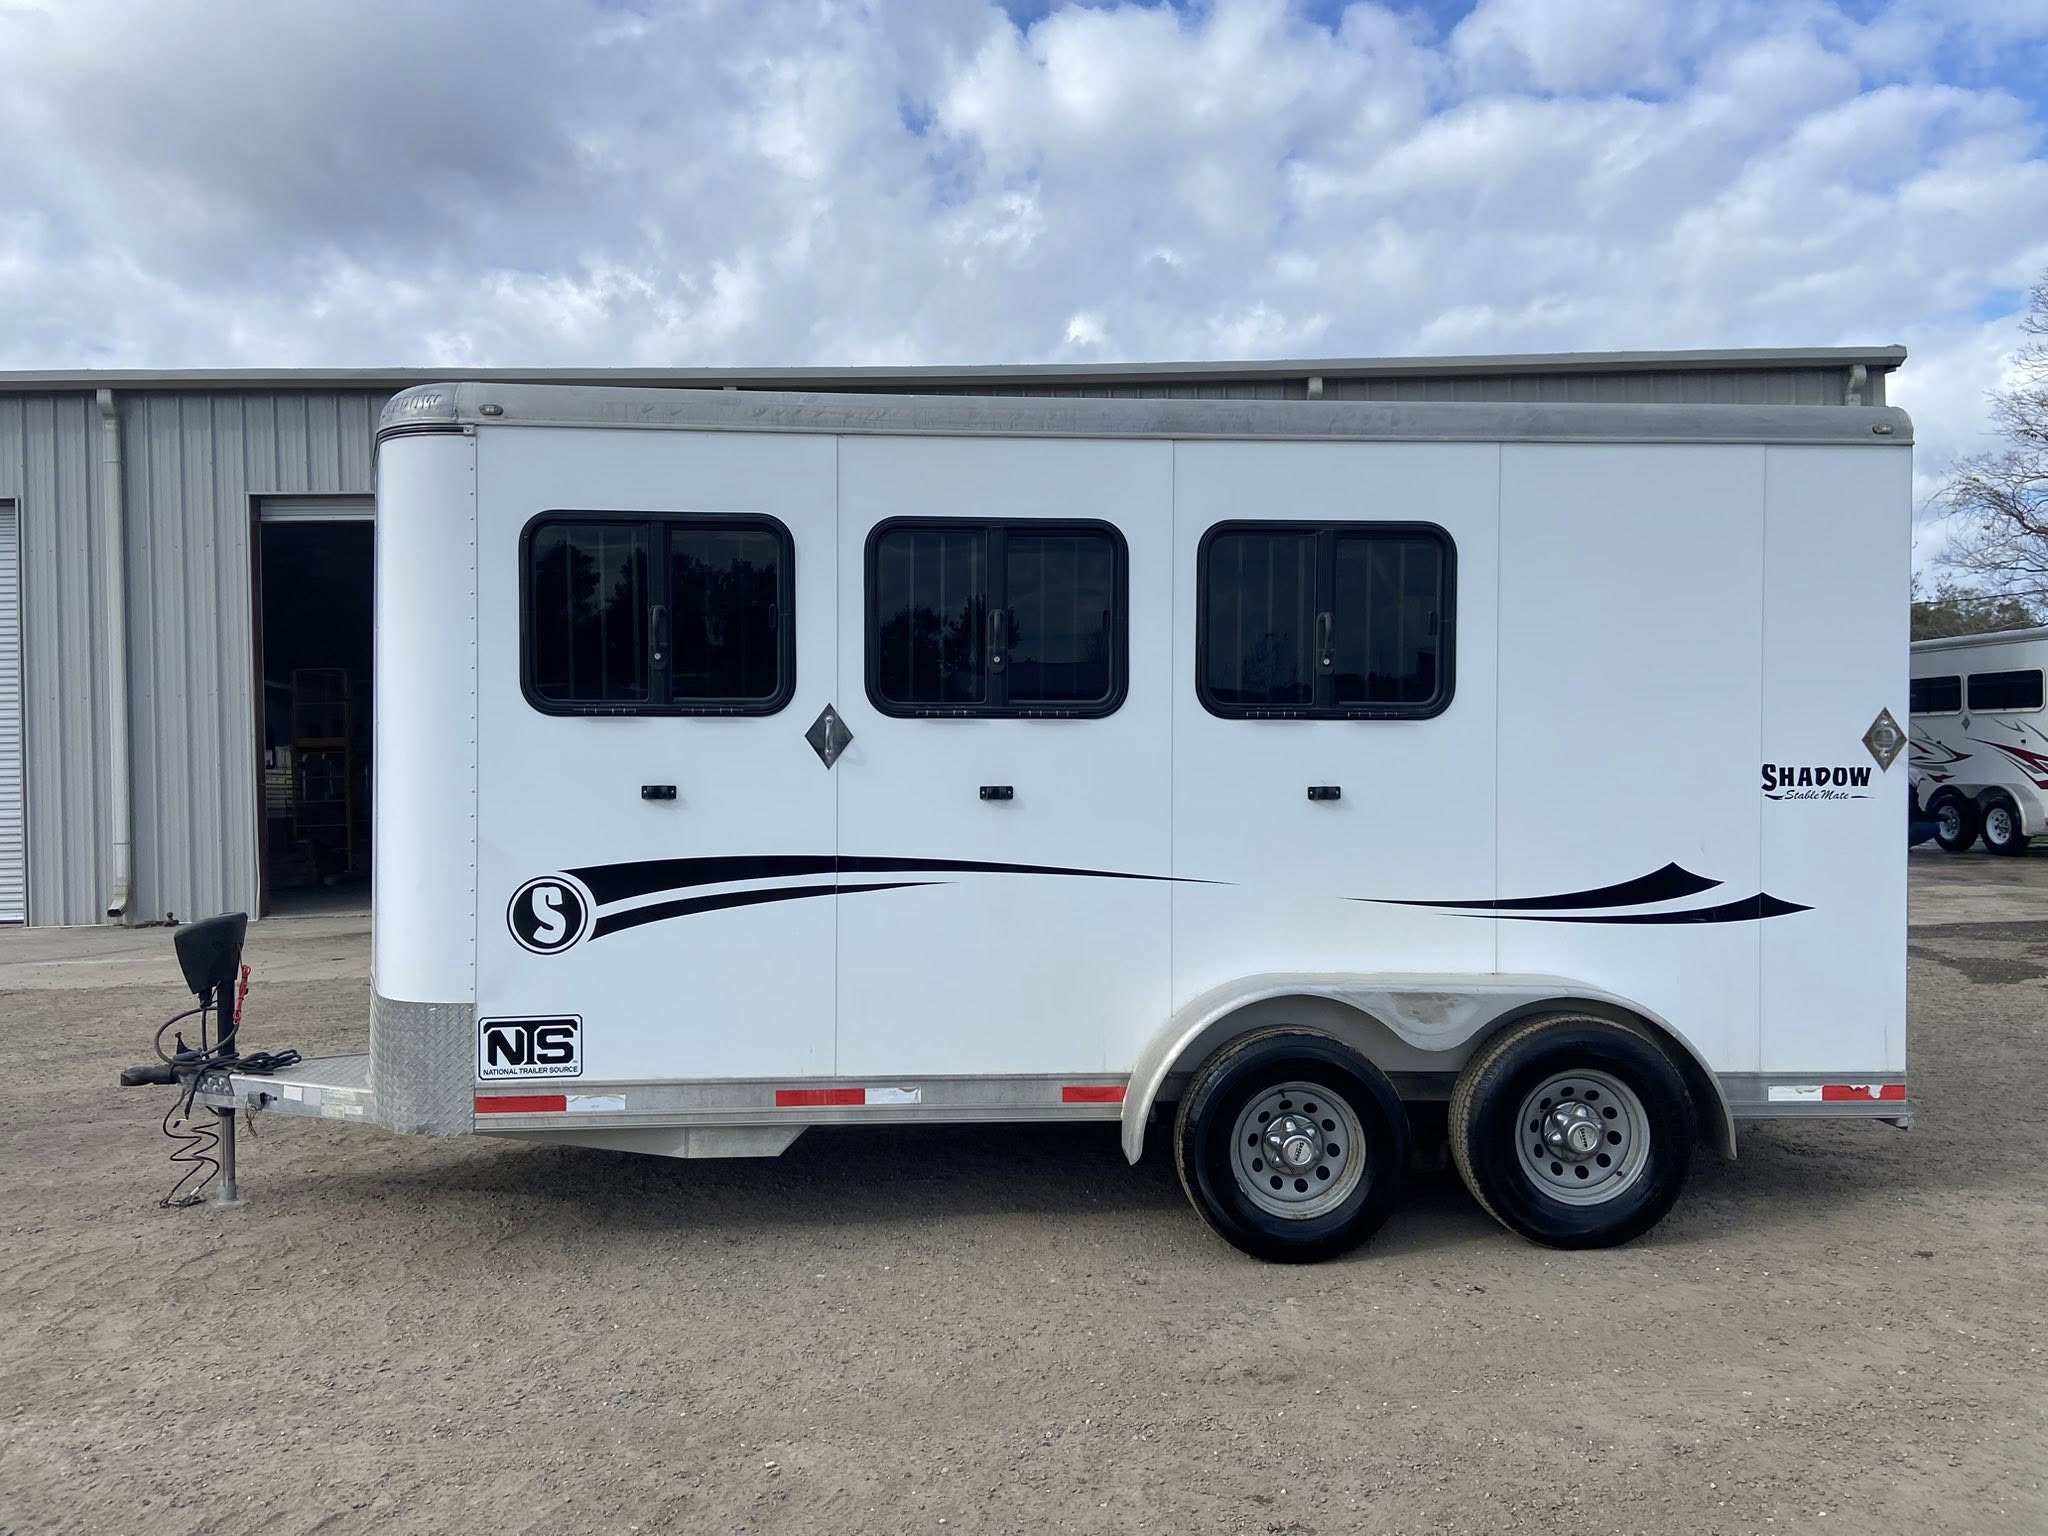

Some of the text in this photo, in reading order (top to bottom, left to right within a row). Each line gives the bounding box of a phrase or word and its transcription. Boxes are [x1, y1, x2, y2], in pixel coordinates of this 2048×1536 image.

[1761, 763, 1872, 791] SHADOW
[1784, 789, 1849, 800] Stable Mate
[532, 886, 566, 944] S
[483, 1065, 578, 1076] NATIONAL TRAILER SOURCE
